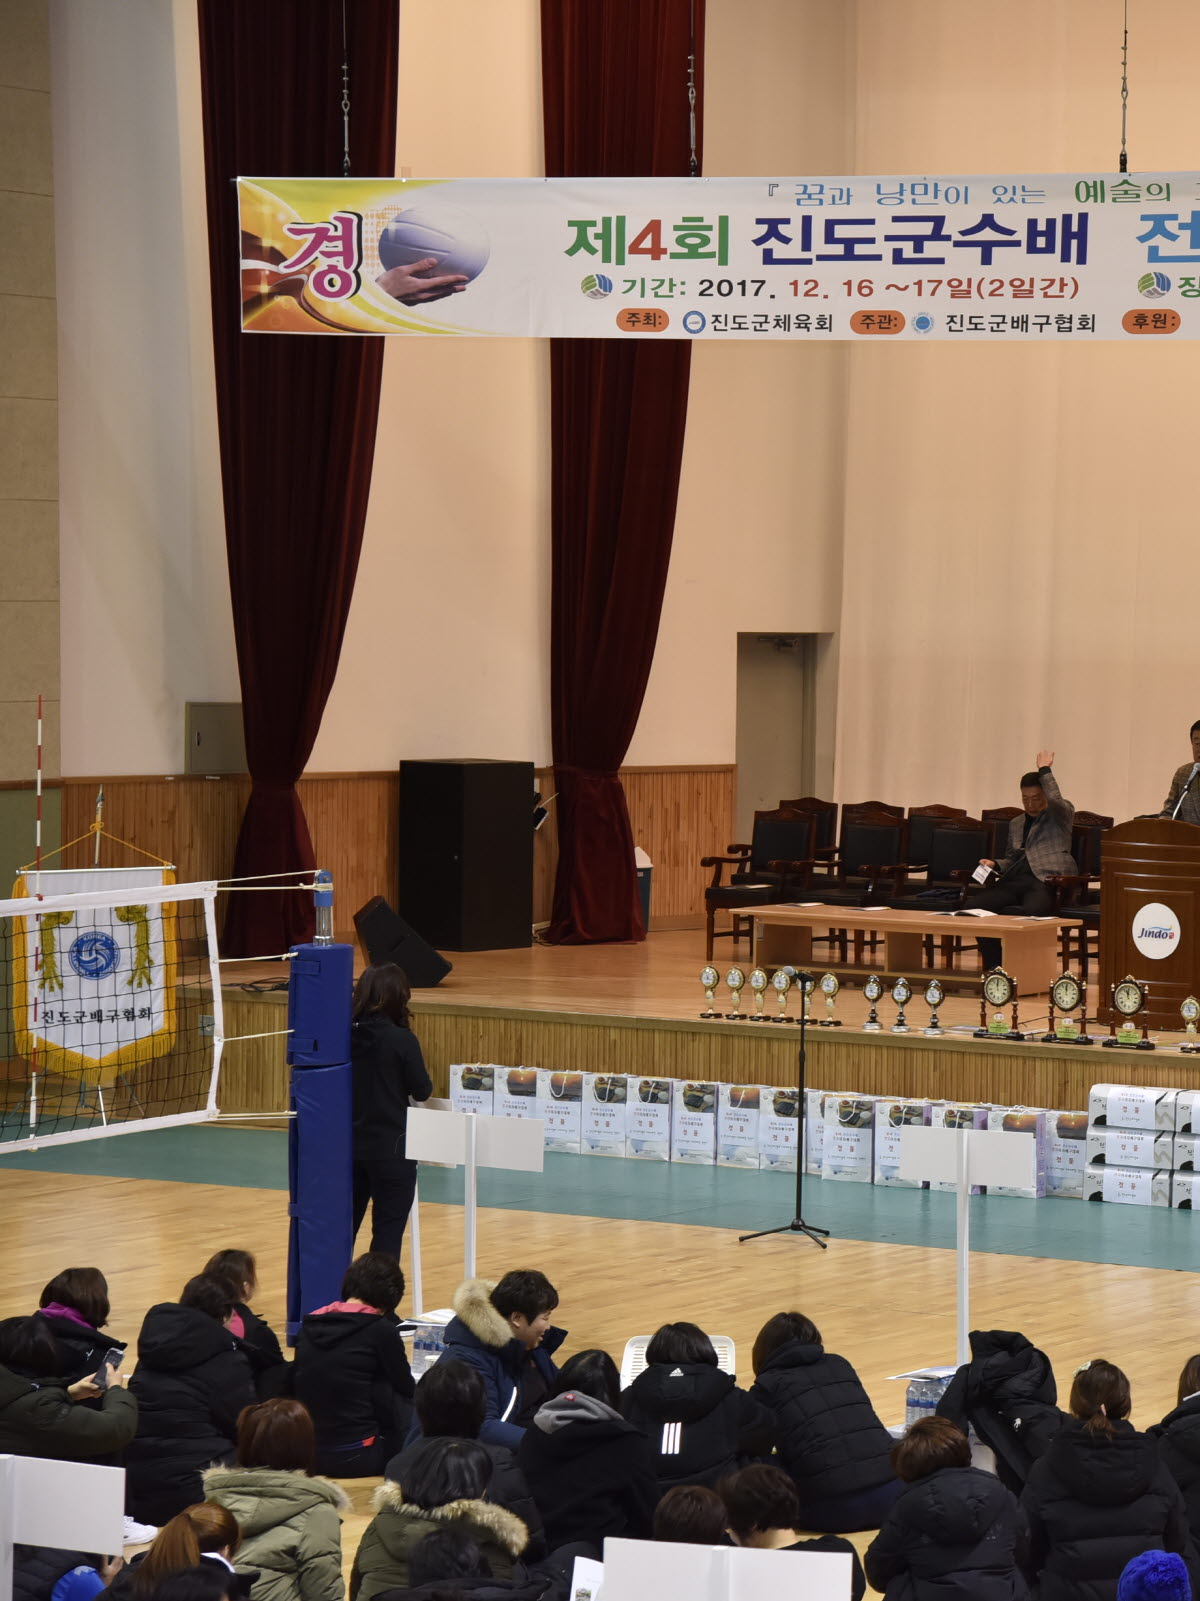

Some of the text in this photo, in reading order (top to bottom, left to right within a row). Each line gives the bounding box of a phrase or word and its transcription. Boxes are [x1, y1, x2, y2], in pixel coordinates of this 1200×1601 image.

[794, 183, 854, 207] 꿈과
[875, 178, 969, 206] 낭만이
[991, 184, 1047, 205] 있는
[1074, 174, 1171, 204] 예술의
[563, 214, 730, 267] 제4회
[750, 211, 1089, 266] 진도군수배
[281, 212, 362, 299] 경
[620, 276, 1079, 300] 기간: 2017. 12. 16 ~17일(2일간)
[625, 312, 833, 333] 주최: 진도군체육회
[859, 313, 1096, 334] 주관: 진도군배구협회
[1132, 313, 1175, 330] 후원:
[1138, 927, 1169, 940] Jindo
[41, 1007, 152, 1024] 진도군배구협회
